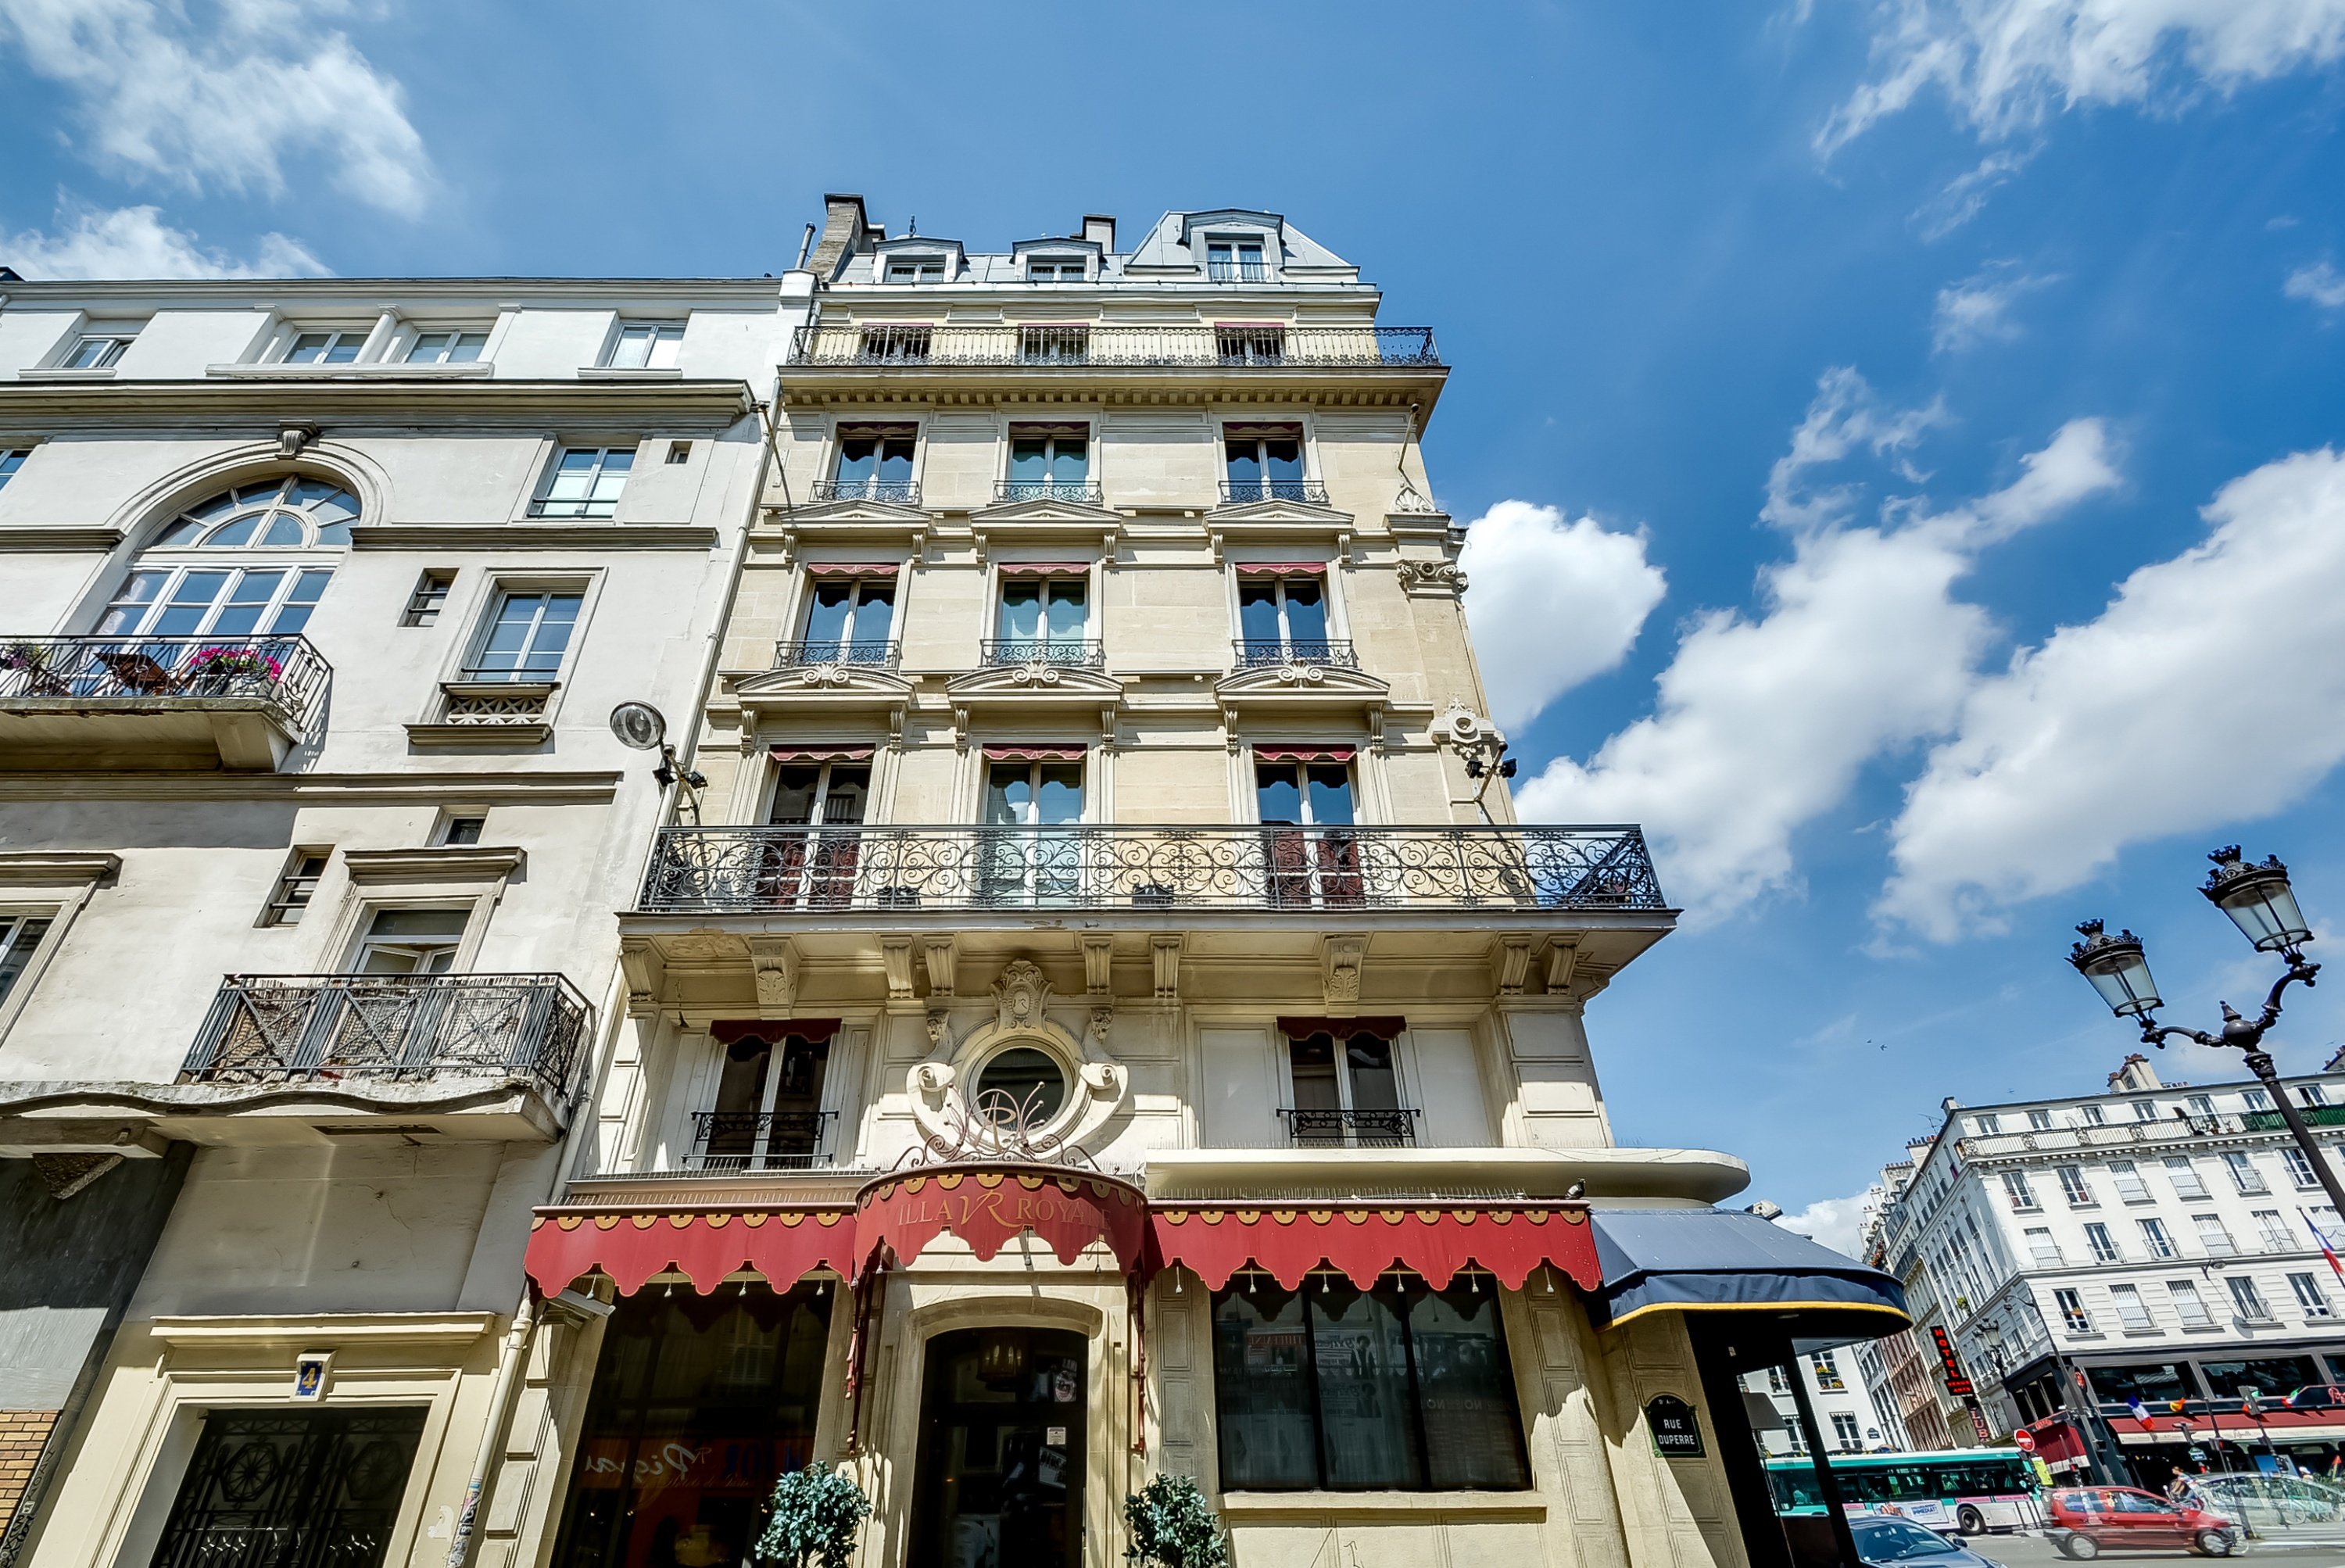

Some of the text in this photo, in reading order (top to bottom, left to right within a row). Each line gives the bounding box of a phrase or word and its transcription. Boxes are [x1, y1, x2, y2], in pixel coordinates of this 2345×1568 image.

[888, 1200, 953, 1226] ILLA
[1016, 1197, 1112, 1231] ROYALE
[1934, 1329, 1960, 1378] HOTEL
[302, 1367, 317, 1389] 4
[1663, 1419, 1683, 1430] RUE
